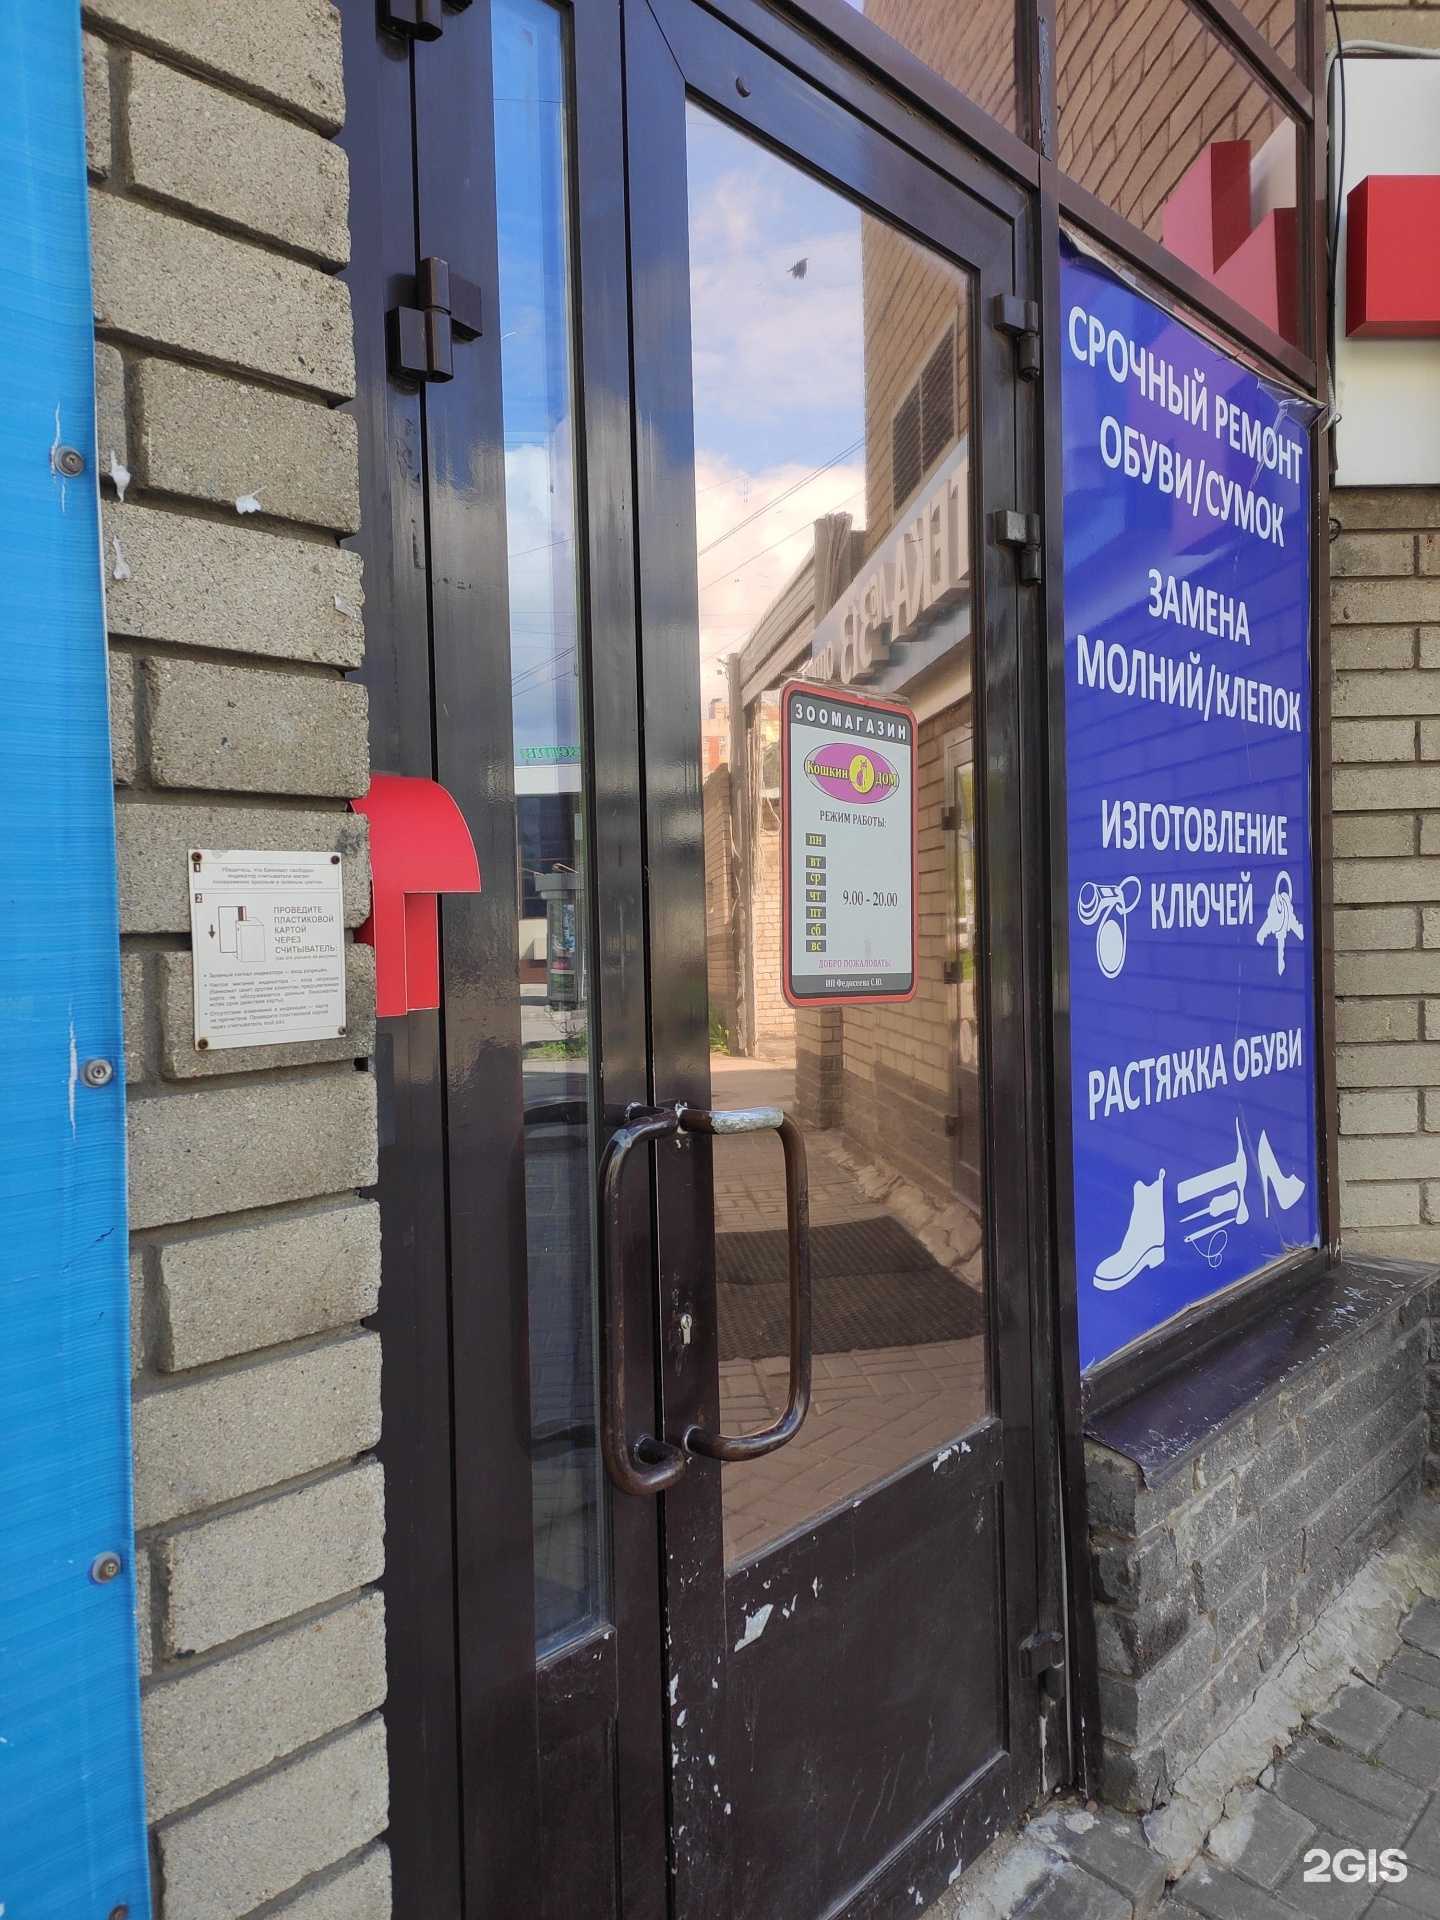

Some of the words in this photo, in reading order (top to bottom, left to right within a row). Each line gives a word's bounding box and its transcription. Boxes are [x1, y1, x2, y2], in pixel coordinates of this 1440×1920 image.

[1068, 305, 1207, 431] СРОЧНЫЙ
[1215, 394, 1303, 484] РЕМОНТ
[1100, 415, 1284, 547] ОБУВИ/СУМОК
[1148, 568, 1251, 646] ЗАМЕНА
[1077, 634, 1301, 732] МОЛНИЙ/КЛЕПОК
[795, 703, 906, 739] ЗООМАГАЗИН
[806, 760, 848, 779] Кошкин
[819, 810, 850, 825] РЕЖИМ
[852, 813, 887, 829] РАБОТЫ:
[1102, 799, 1287, 857] ИЗГОТОВЛЕНИЕ
[842, 889, 864, 906] 9.00
[872, 891, 898, 907] 20.00
[1151, 872, 1254, 930] КЛЮЧЕЙ
[273, 906, 323, 914] ПРОВЕДИТЕ
[273, 915, 334, 923] ПЛАСТИКОВОЙ
[274, 926, 307, 934] КАРТОЙ
[274, 935, 301, 944] ЧЕРЕЗ
[275, 944, 336, 954] СЧИТЫВАТЕЛЬ
[818, 959, 841, 969] ДОБРО
[825, 978, 835, 988] ИП
[1088, 1042, 1228, 1121] РАСТЯЖКА
[1232, 1028, 1303, 1082] ОБУВИ
